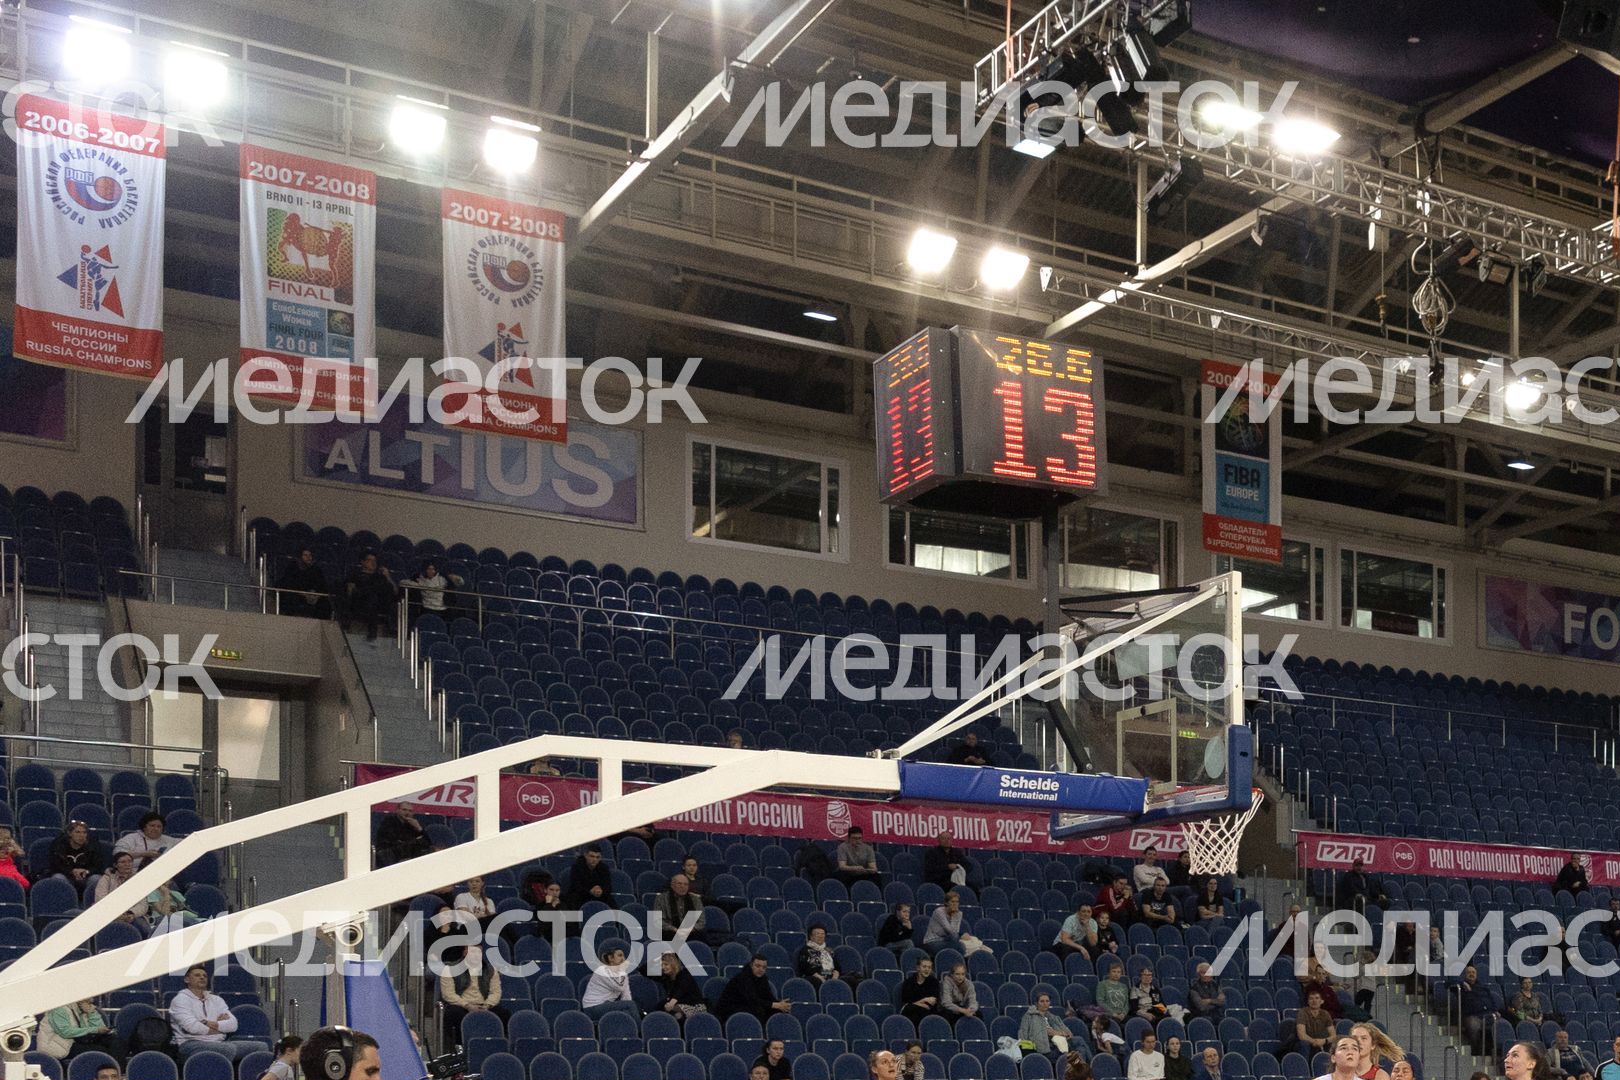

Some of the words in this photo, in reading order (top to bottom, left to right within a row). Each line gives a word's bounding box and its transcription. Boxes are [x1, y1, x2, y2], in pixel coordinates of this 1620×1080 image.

[24, 111, 160, 153] 2006-2007
[249, 161, 370, 200] 2007-2008
[266, 191, 293, 204] BRNO
[312, 200, 322, 210] 13
[326, 202, 354, 216] APRIL
[450, 202, 561, 238] 2007-2008
[267, 280, 331, 301] FINAL
[52, 321, 129, 343] ЧЕМПИОНЫ
[63, 335, 117, 353] РОССИИ
[26, 340, 74, 357] RUSSIA
[76, 350, 152, 370] CHAMPIONS
[275, 336, 317, 354] 2008
[996, 335, 1092, 383] 26.6
[993, 380, 1096, 486] 13
[324, 429, 614, 508] ALTIUS
[1224, 463, 1260, 488] FIBA
[1225, 485, 1260, 500] EUROPE
[999, 788, 1058, 801] International
[1000, 775, 1060, 791] Schelde
[521, 794, 550, 805] РФБ
[736, 801, 804, 829] РОССИИ
[1319, 843, 1374, 862] PARI
[1395, 852, 1413, 861] РФБ
[1456, 850, 1521, 873] ЧЕМПИОНАТ
[1524, 855, 1564, 875] РОССИИ
